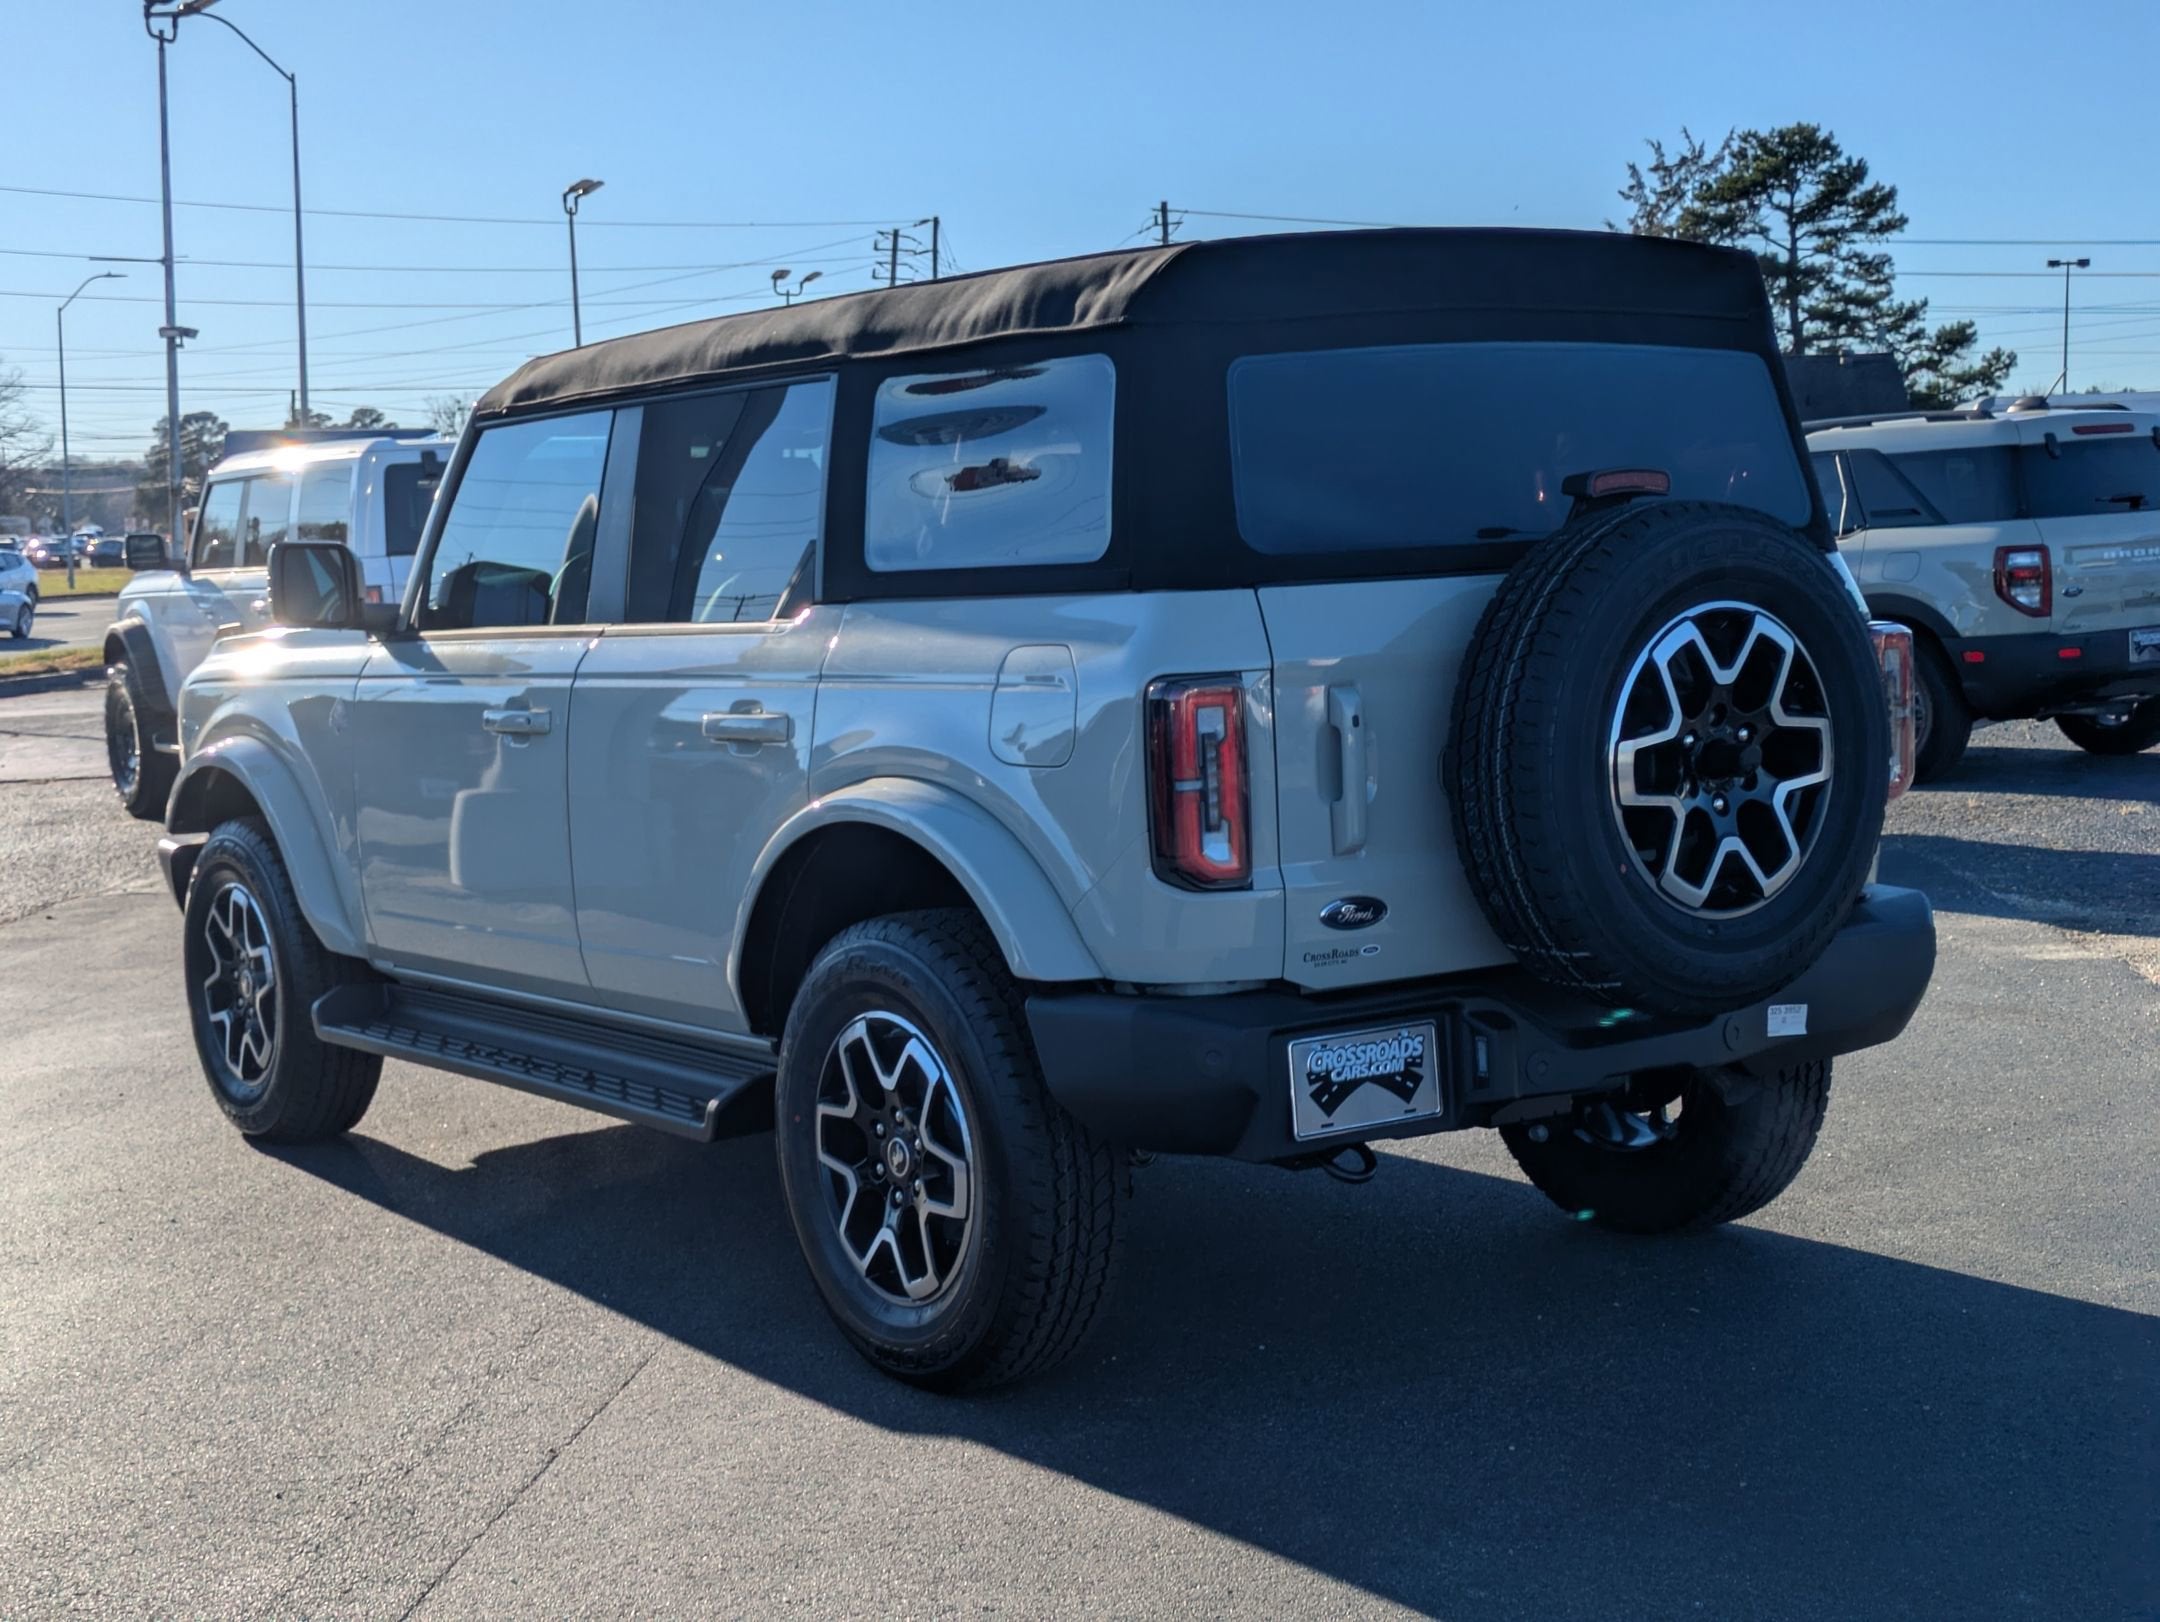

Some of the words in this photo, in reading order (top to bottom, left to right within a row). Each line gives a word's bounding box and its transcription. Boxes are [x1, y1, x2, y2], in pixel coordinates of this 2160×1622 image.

[1337, 904, 1374, 923] Ford
[1307, 1034, 1425, 1074] CROSSROADS
[1331, 1058, 1405, 1082] CARS.COM
